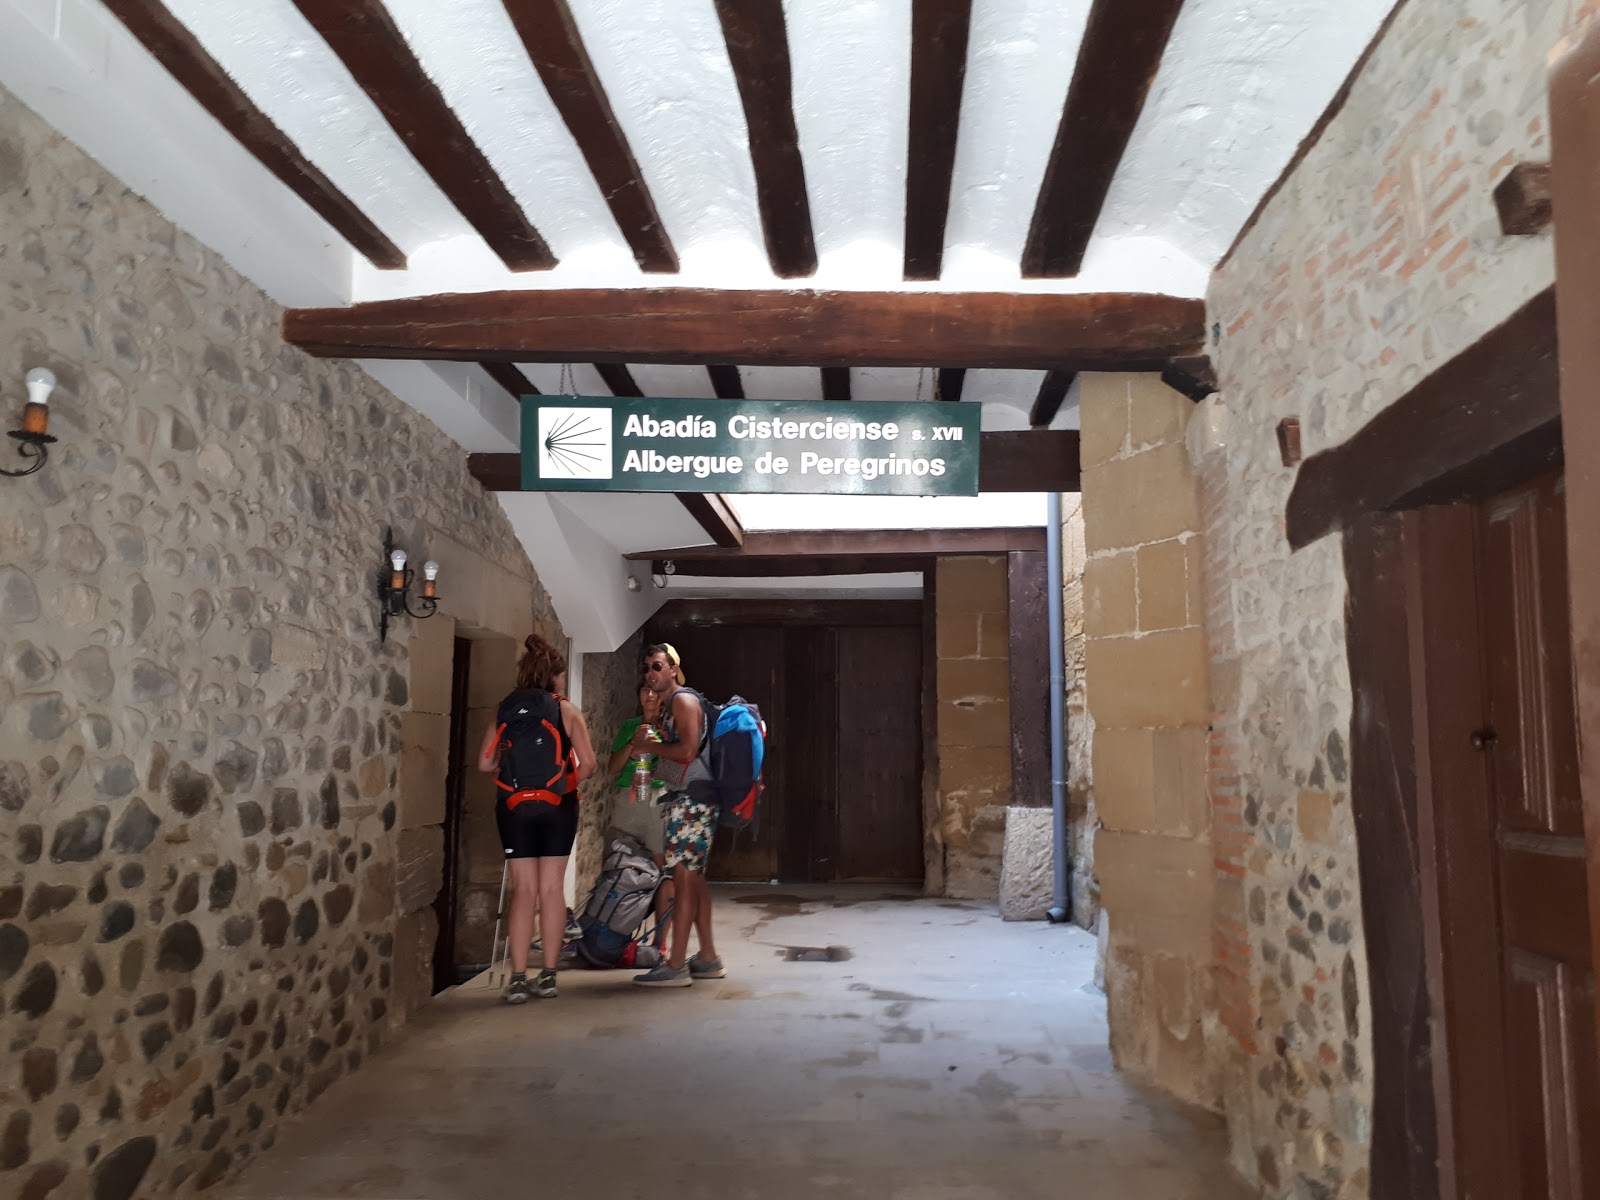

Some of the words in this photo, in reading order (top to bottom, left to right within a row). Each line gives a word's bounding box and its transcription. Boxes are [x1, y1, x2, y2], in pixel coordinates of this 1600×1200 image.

[623, 414, 717, 440] Abadía
[728, 415, 899, 441] Cisterciense
[931, 426, 963, 441] XVII
[622, 449, 744, 479] Albergue
[755, 451, 789, 475] de
[801, 452, 946, 481] Peregrinos
